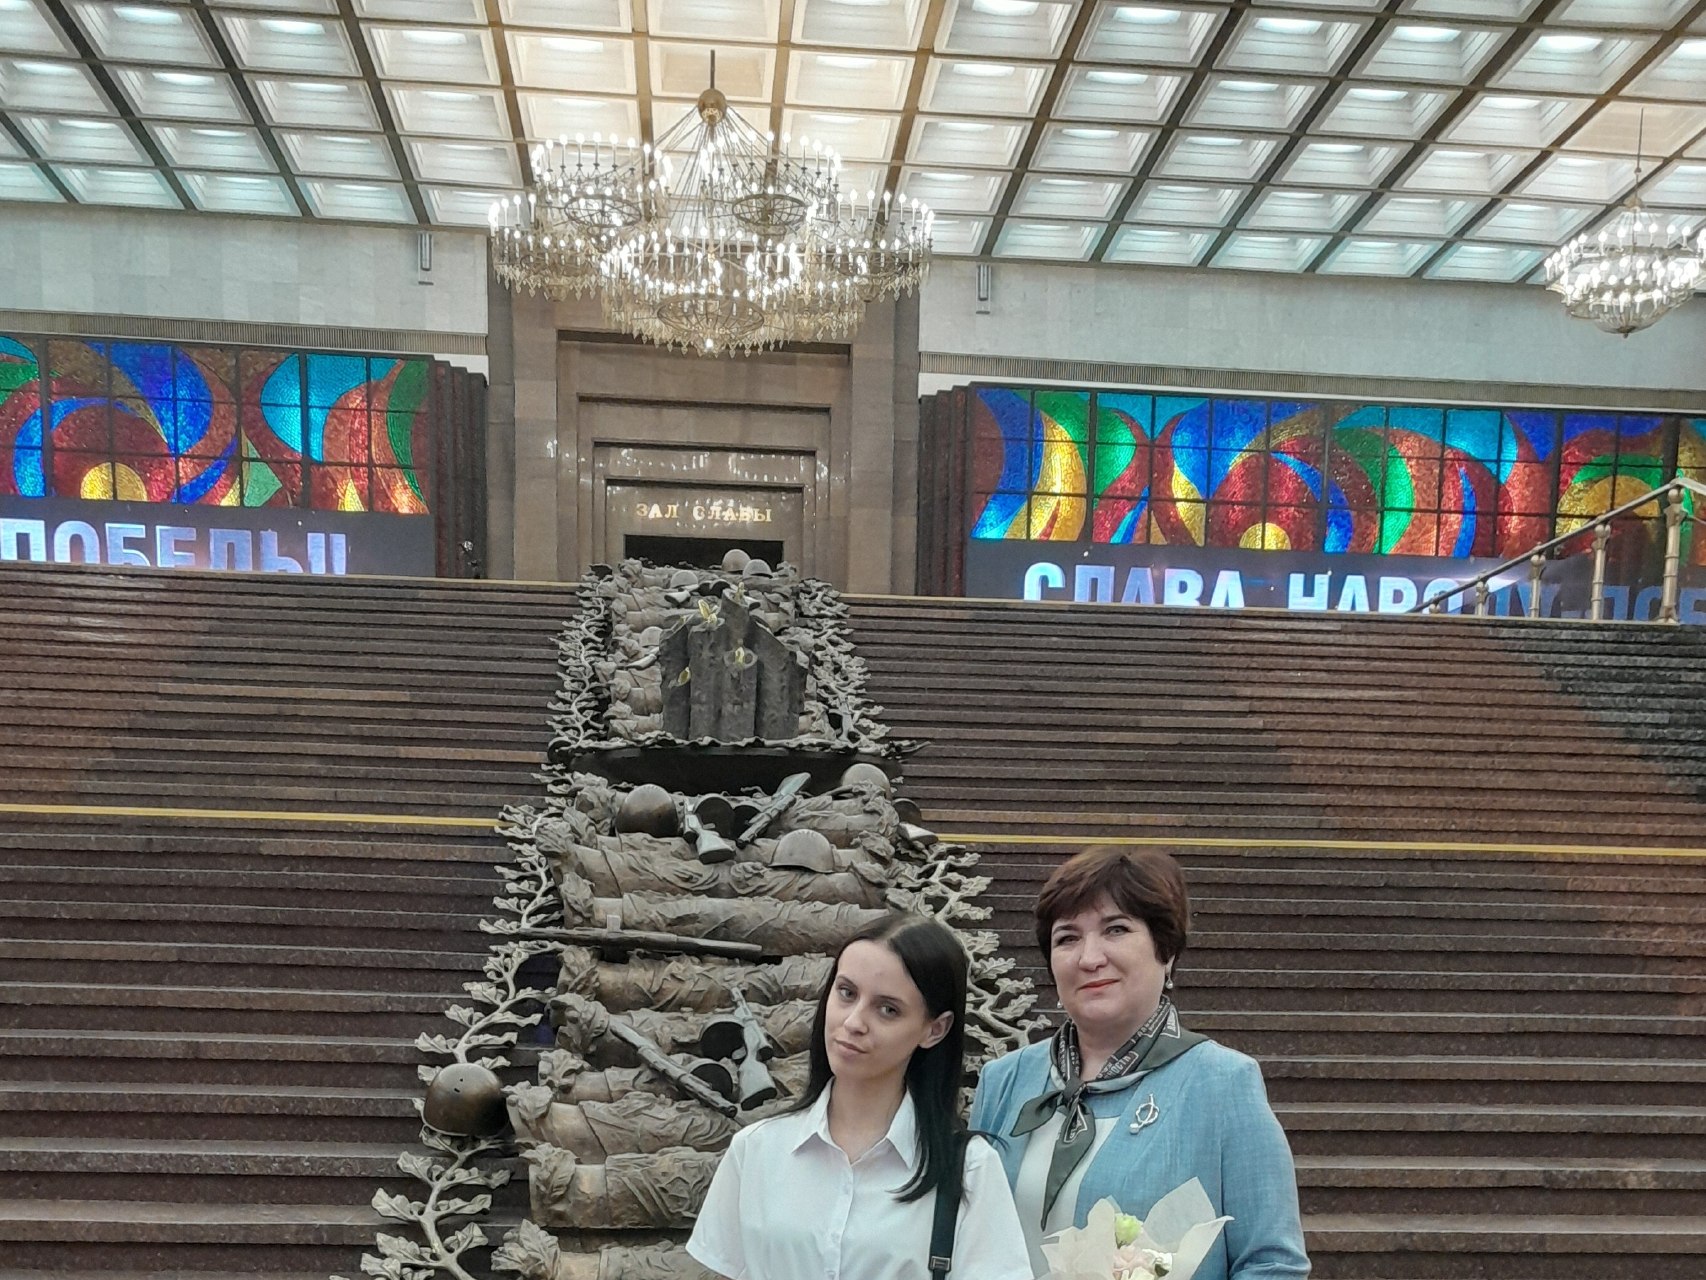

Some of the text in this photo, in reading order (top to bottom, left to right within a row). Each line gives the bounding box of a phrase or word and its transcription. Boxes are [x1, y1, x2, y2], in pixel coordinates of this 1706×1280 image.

[635, 503, 772, 523] ЗАЛ СЛАВЫ
[1024, 562, 1245, 609] СЛАВА
